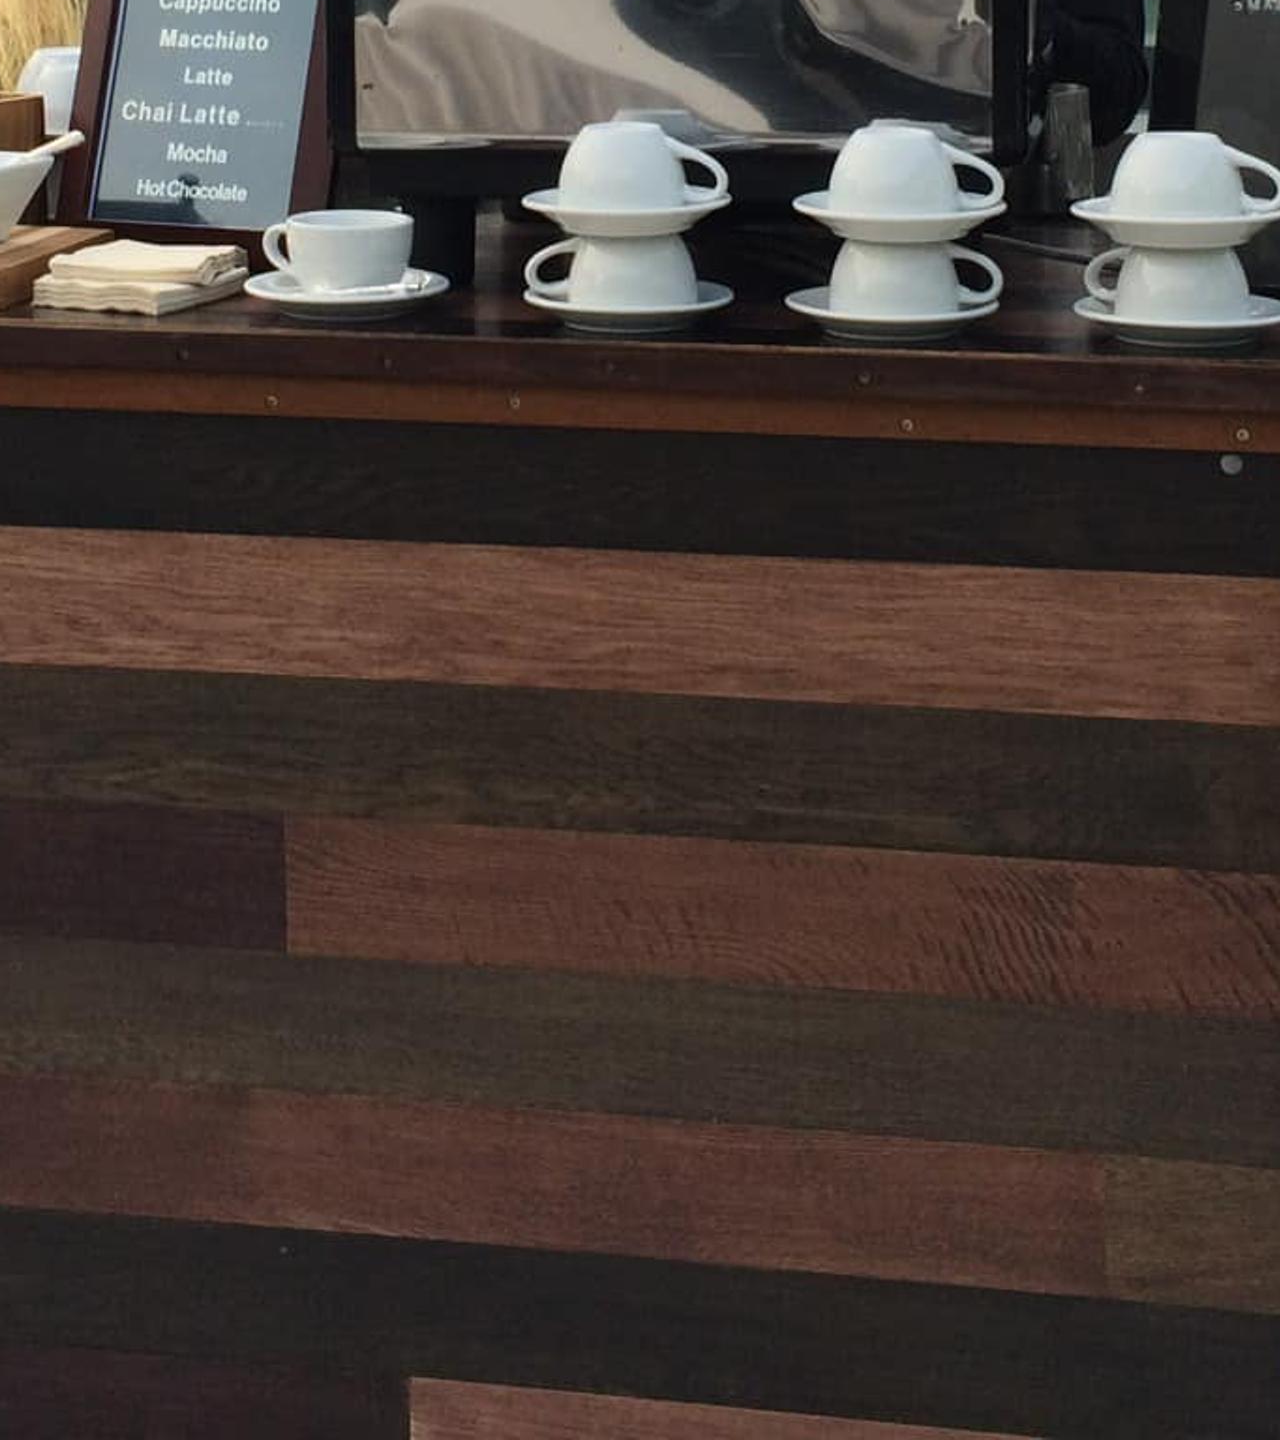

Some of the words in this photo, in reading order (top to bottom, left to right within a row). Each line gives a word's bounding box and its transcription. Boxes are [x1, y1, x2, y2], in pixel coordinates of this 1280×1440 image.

[159, 29, 269, 52] Macchiato
[183, 67, 233, 86] Latte
[121, 101, 173, 123] Chai
[179, 103, 241, 127] Latte
[166, 143, 228, 164] Mocha
[136, 179, 167, 198] Hot
[167, 180, 248, 203] Chocolate
